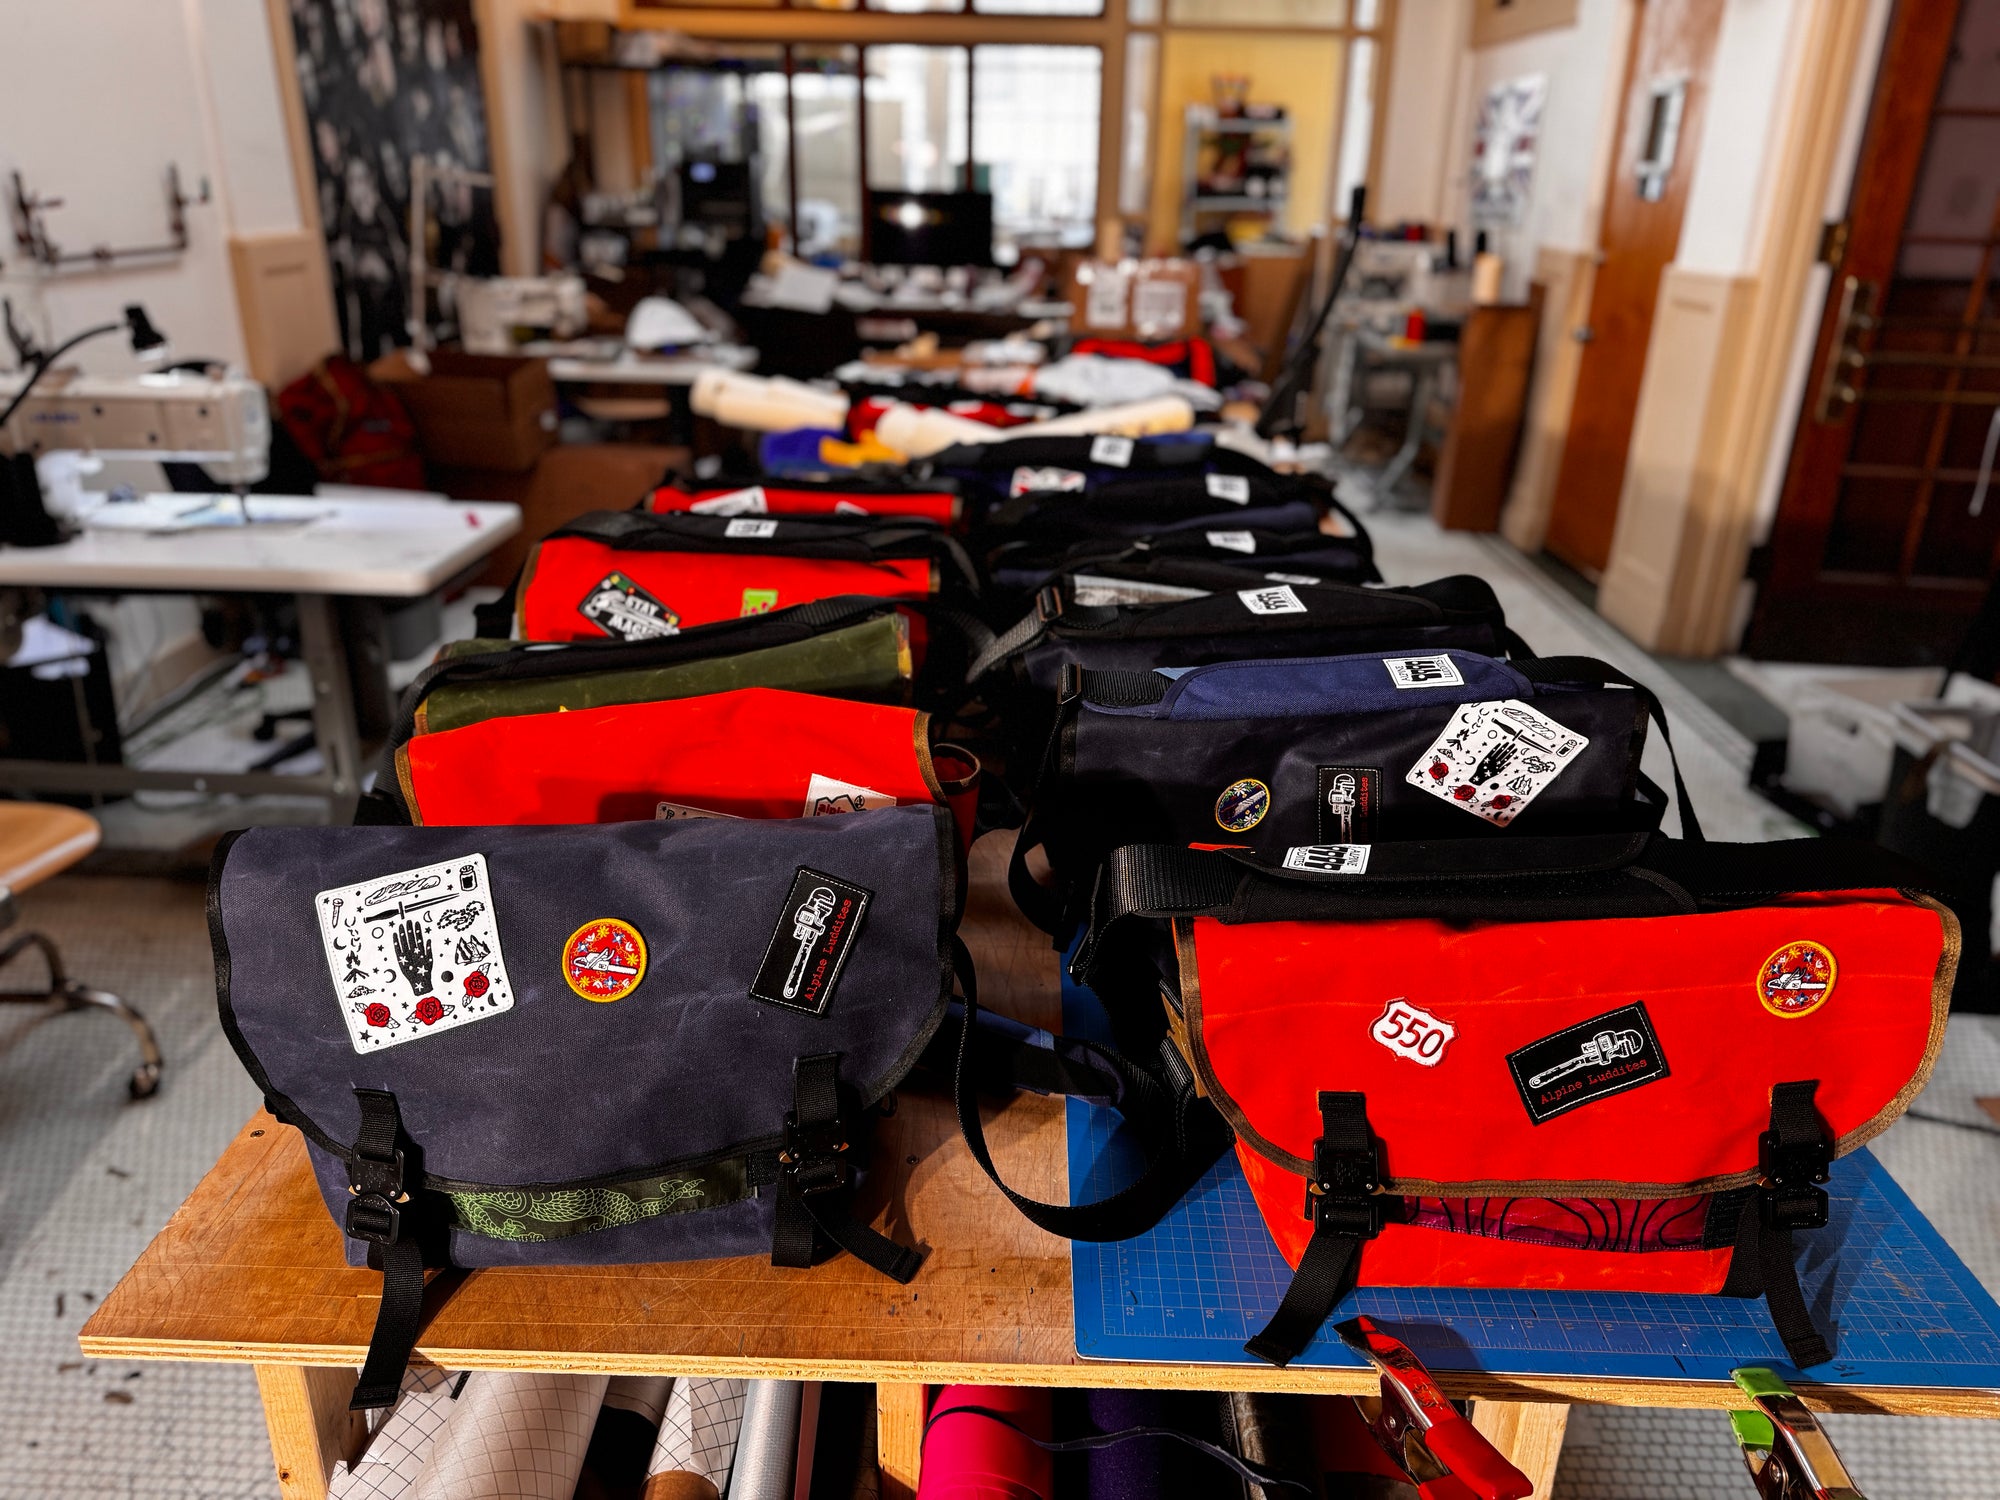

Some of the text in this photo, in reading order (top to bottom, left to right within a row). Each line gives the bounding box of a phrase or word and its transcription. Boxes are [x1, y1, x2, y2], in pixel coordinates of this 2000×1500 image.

[804, 898, 852, 1001] Alpine Luddites
[1381, 1009, 1445, 1058] 550
[1540, 1059, 1648, 1105] Alpine Luddites
[1126, 1305, 1135, 1317] 22
[1166, 1308, 1175, 1318] 21
